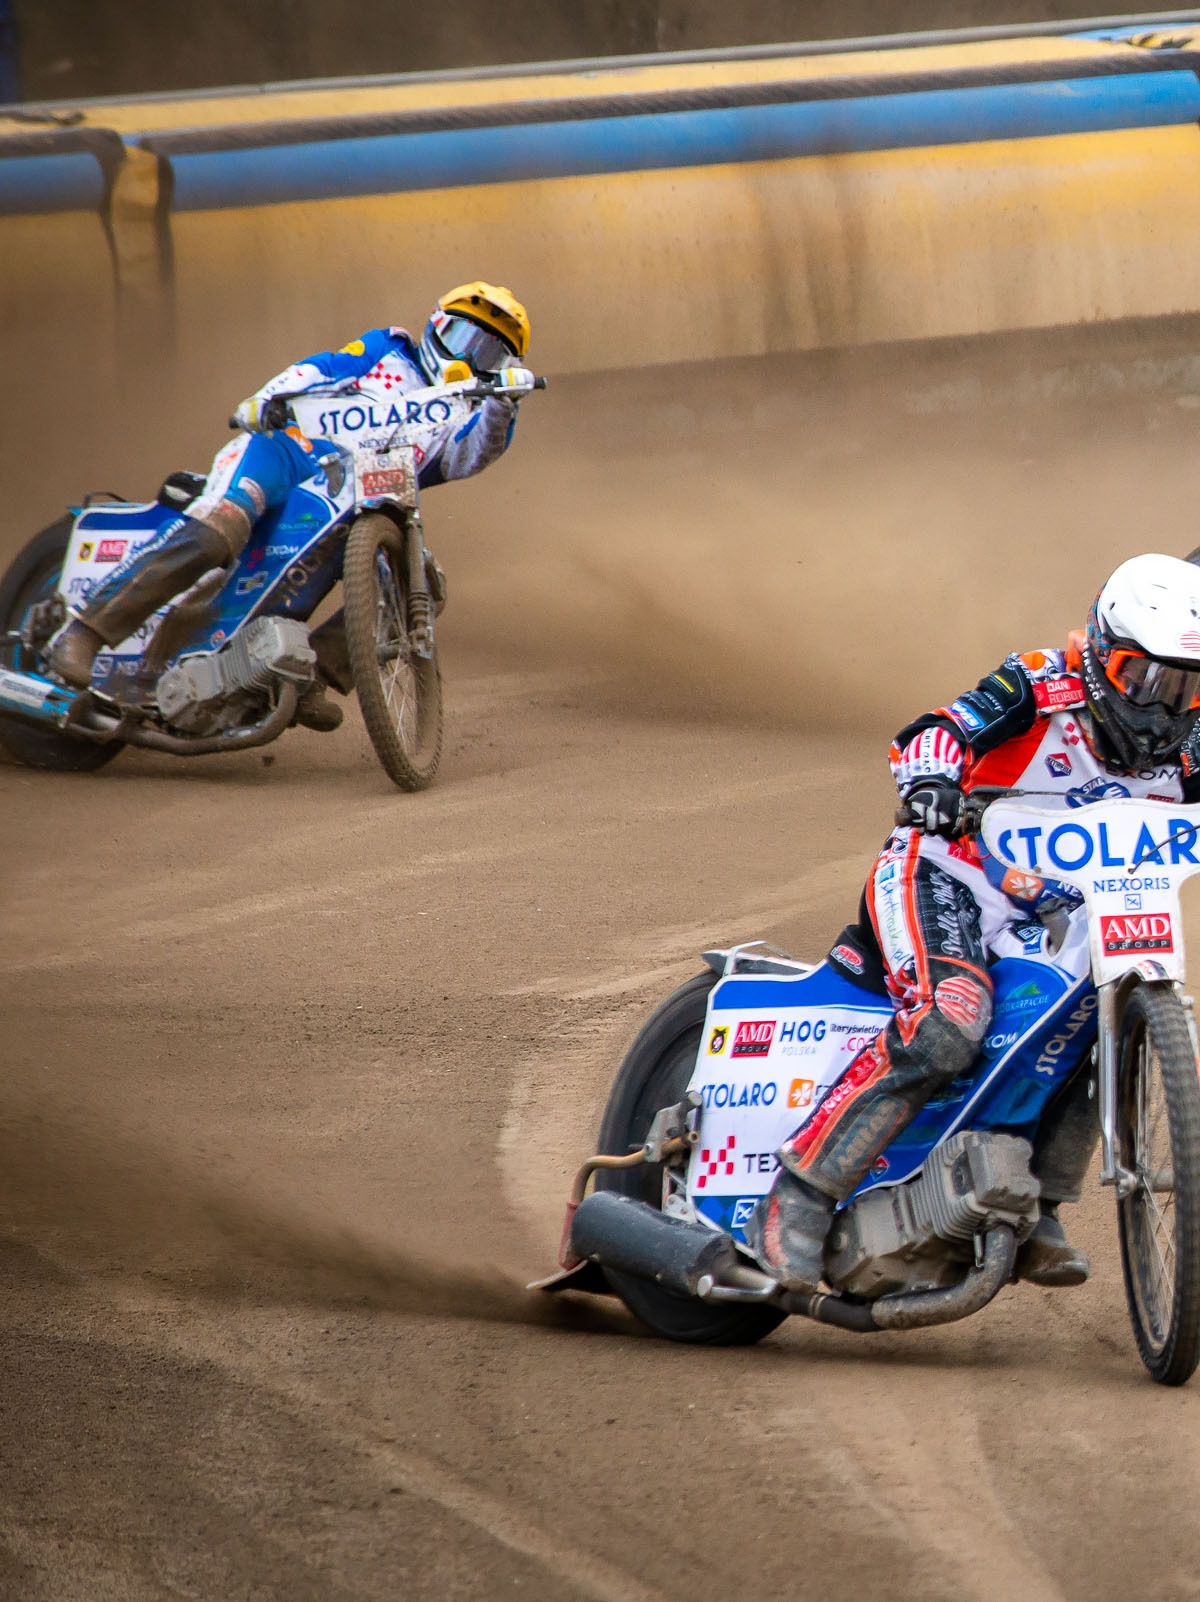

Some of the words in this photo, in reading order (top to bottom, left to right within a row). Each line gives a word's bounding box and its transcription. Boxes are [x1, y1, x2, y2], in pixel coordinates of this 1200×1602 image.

[319, 399, 451, 435] STOLARO
[1046, 681, 1069, 693] DAN
[1092, 877, 1170, 893] NEXORIS
[1104, 916, 1171, 939] AMD
[1107, 940, 1169, 951] GROUP
[734, 1023, 775, 1043] AMD
[779, 1020, 827, 1043] HOG
[983, 1031, 1019, 1049] XOM
[1035, 994, 1098, 1076] STOLARO
[743, 1153, 781, 1174] TEX
